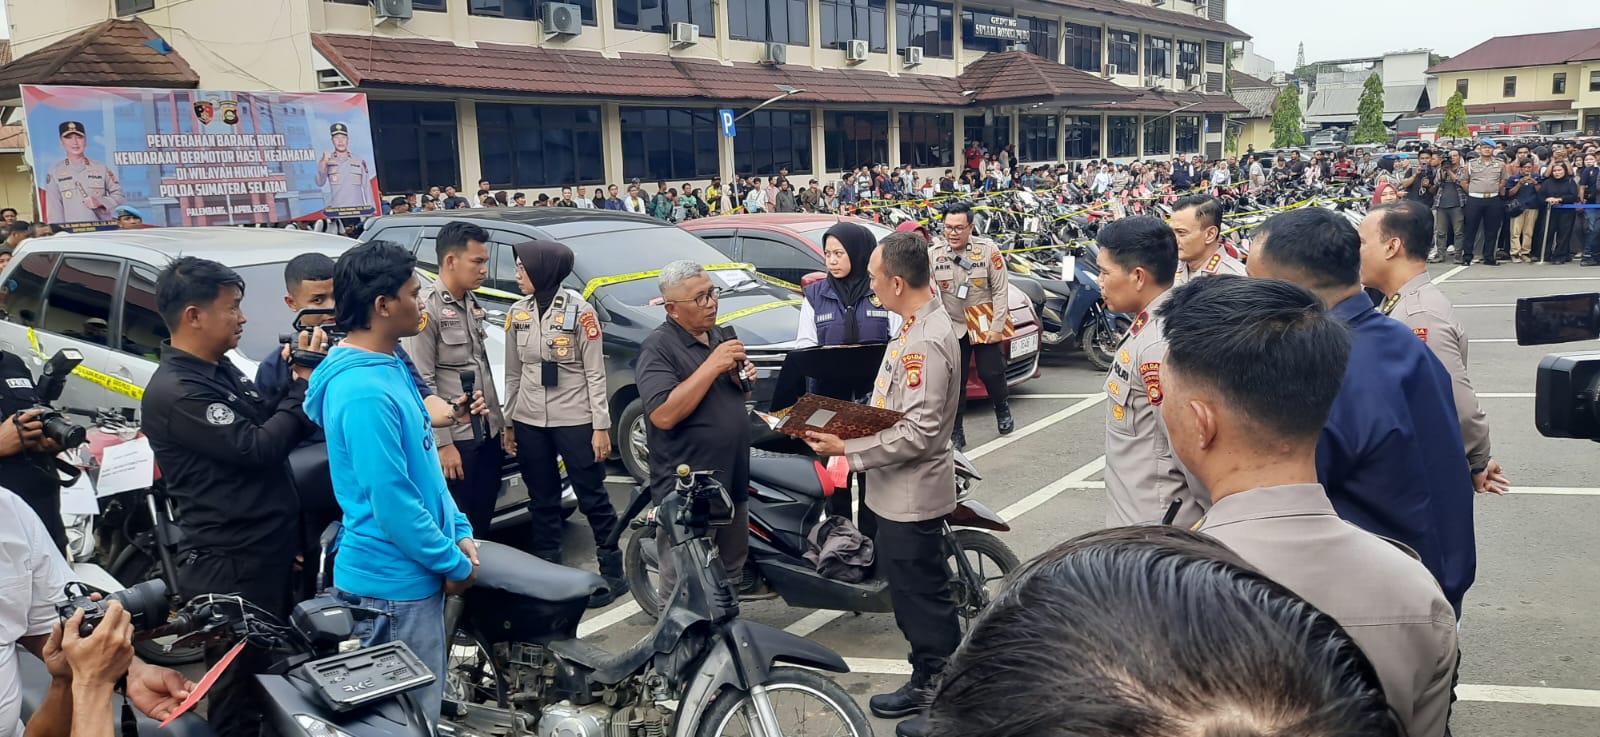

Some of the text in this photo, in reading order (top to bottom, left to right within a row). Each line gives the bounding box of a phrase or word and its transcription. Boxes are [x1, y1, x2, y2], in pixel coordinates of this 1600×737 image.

[724, 112, 733, 134] P
[147, 134, 286, 148] PENYERAHAN BARANG BUKTI
[114, 149, 316, 165] KENDARAAN BERMOTOR HASIL KEJAHATAN
[176, 165, 269, 180] DI WILAYAH HUKUM
[160, 181, 288, 197] POLDA SUMATERA SELATAN
